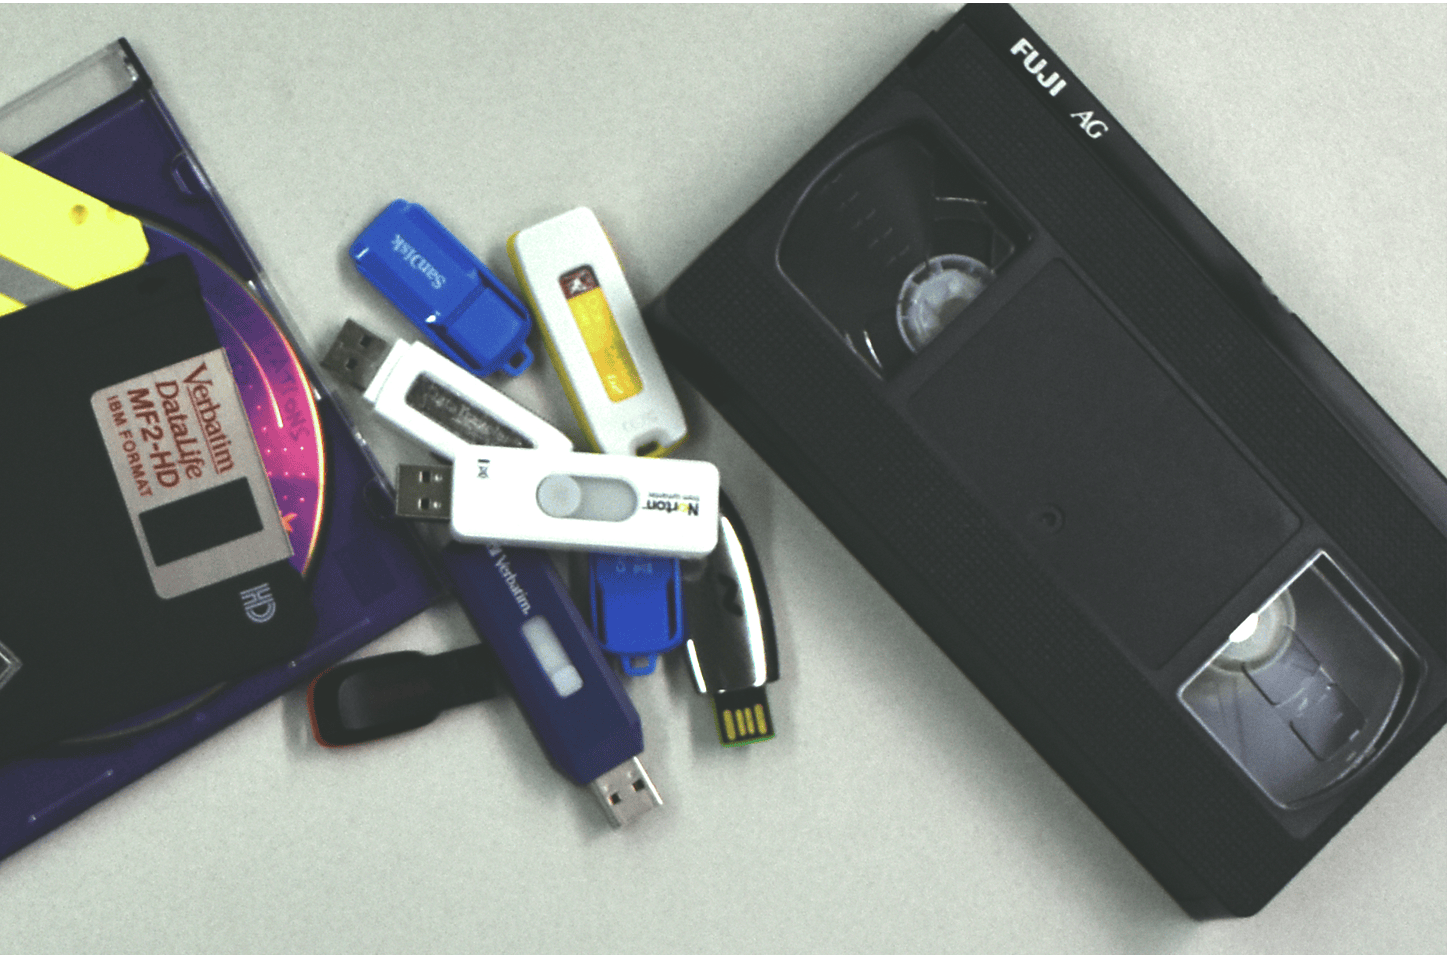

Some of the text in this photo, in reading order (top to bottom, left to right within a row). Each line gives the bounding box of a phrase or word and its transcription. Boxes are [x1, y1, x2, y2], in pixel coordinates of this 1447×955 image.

[1010, 37, 1109, 139] FUJI AG
[391, 234, 446, 289] SanDisk
[107, 395, 153, 497] IBM FORMAT
[127, 388, 180, 488] MF2-HD
[155, 380, 205, 480] DataLife
[183, 363, 234, 475] Verbatim
[646, 499, 699, 516] Norton
[240, 583, 276, 623] HD
